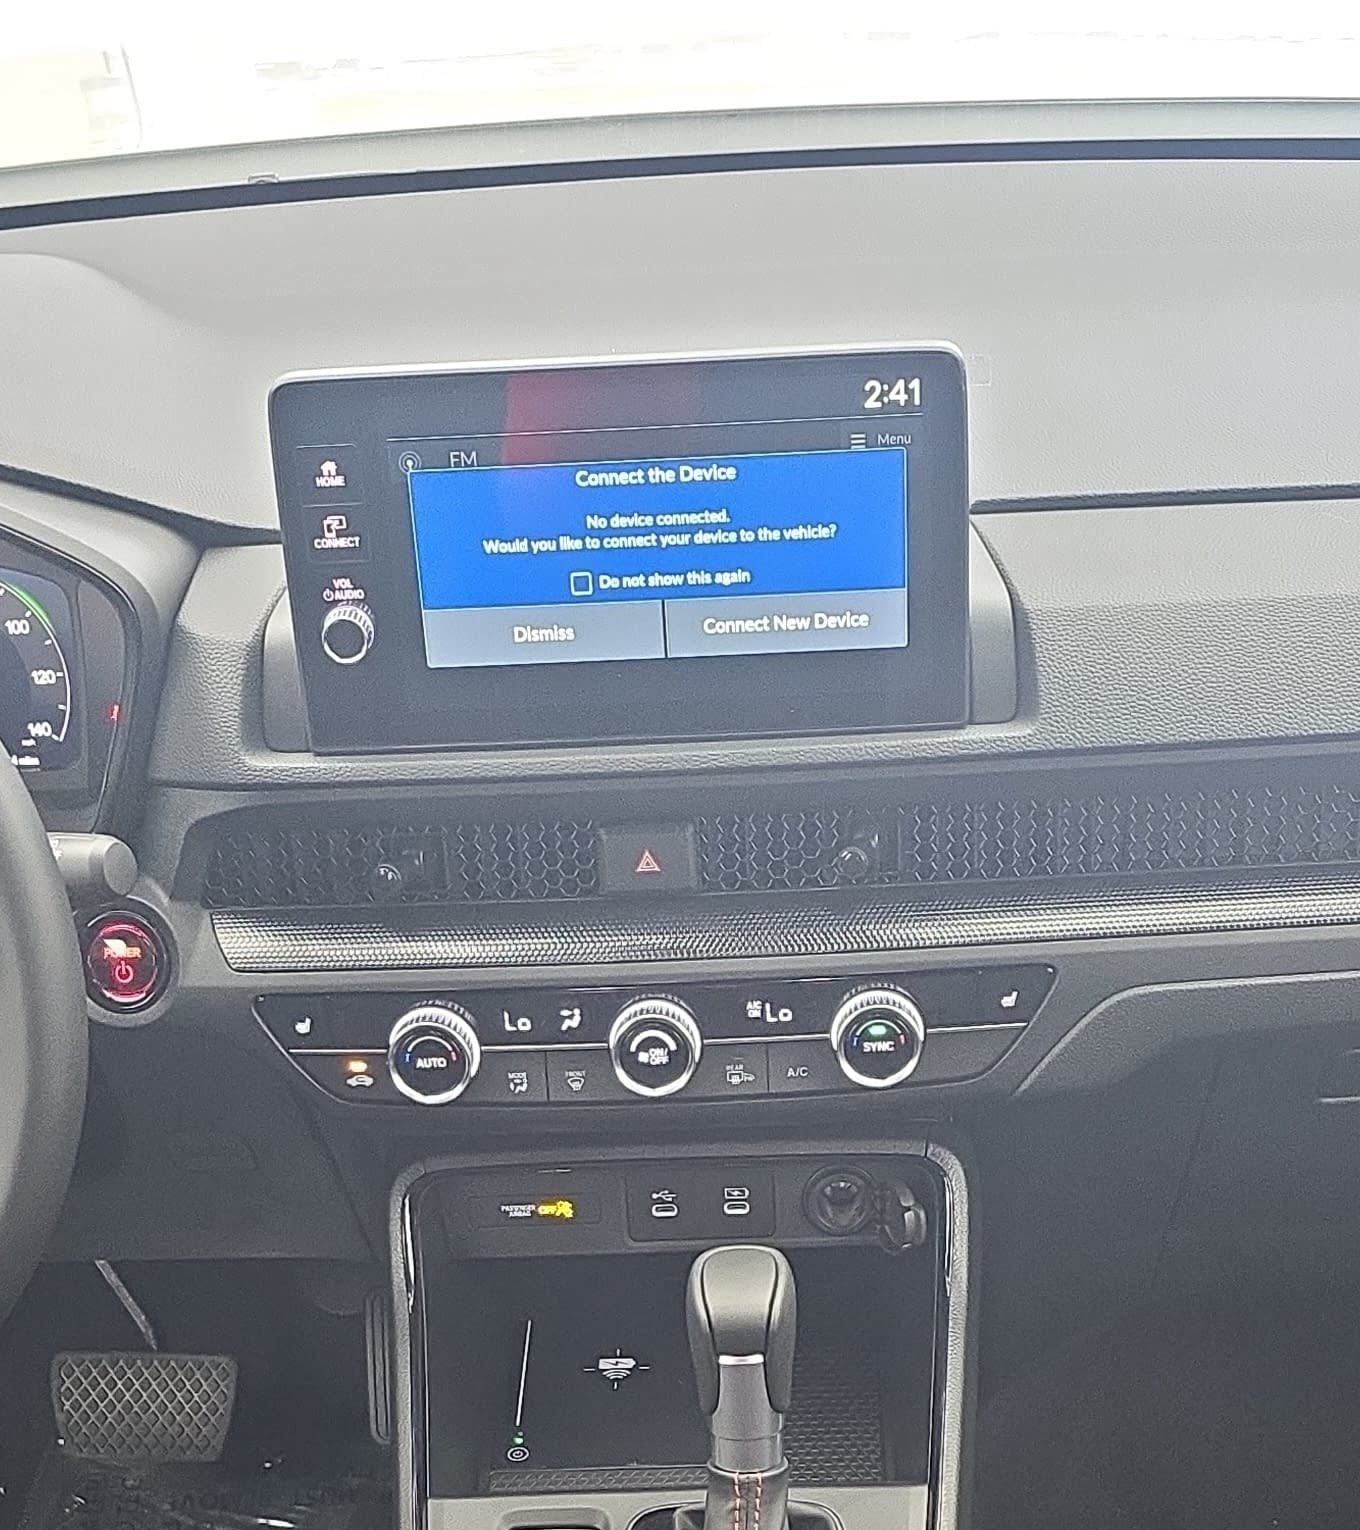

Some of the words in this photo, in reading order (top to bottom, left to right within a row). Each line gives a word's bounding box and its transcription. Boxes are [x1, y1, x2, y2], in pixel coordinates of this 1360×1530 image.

[864, 377, 921, 409] 2:41
[878, 433, 912, 445] Menu
[449, 451, 478, 467] FM
[316, 476, 345, 487] HOME
[575, 468, 645, 486] Connect
[648, 467, 675, 483] the
[679, 464, 736, 482] Device
[586, 515, 607, 528] No
[610, 513, 654, 527] device
[656, 509, 730, 525] connected.
[314, 536, 360, 549] CONNECT
[483, 538, 528, 554] Would
[532, 539, 557, 554] you
[560, 536, 582, 550] like
[585, 536, 600, 549] to
[603, 533, 657, 548] connect
[660, 533, 691, 548] your
[694, 529, 738, 545] device
[740, 529, 755, 542] to
[757, 527, 781, 541] the
[783, 524, 837, 540] vehicle?
[332, 578, 353, 588] VOL
[599, 574, 620, 589] Do
[623, 573, 646, 588] not
[649, 571, 684, 587] show
[686, 570, 712, 586] this
[714, 569, 751, 587] again
[335, 588, 364, 600] AUDIO
[4, 619, 30, 635] 100
[703, 615, 770, 635] Connect
[773, 614, 810, 632] New
[814, 611, 870, 630] Device
[514, 625, 575, 643] Dismiss
[31, 670, 56, 685] 120
[27, 722, 52, 737] 140
[746, 1001, 762, 1011] A/C
[765, 1002, 793, 1022] Lo
[503, 1010, 532, 1032] Lo
[649, 1046, 669, 1057] ON/
[863, 1041, 895, 1052] SYNC
[416, 1058, 447, 1069] AUTO
[649, 1056, 669, 1066] OFF
[787, 1067, 808, 1077] A/C
